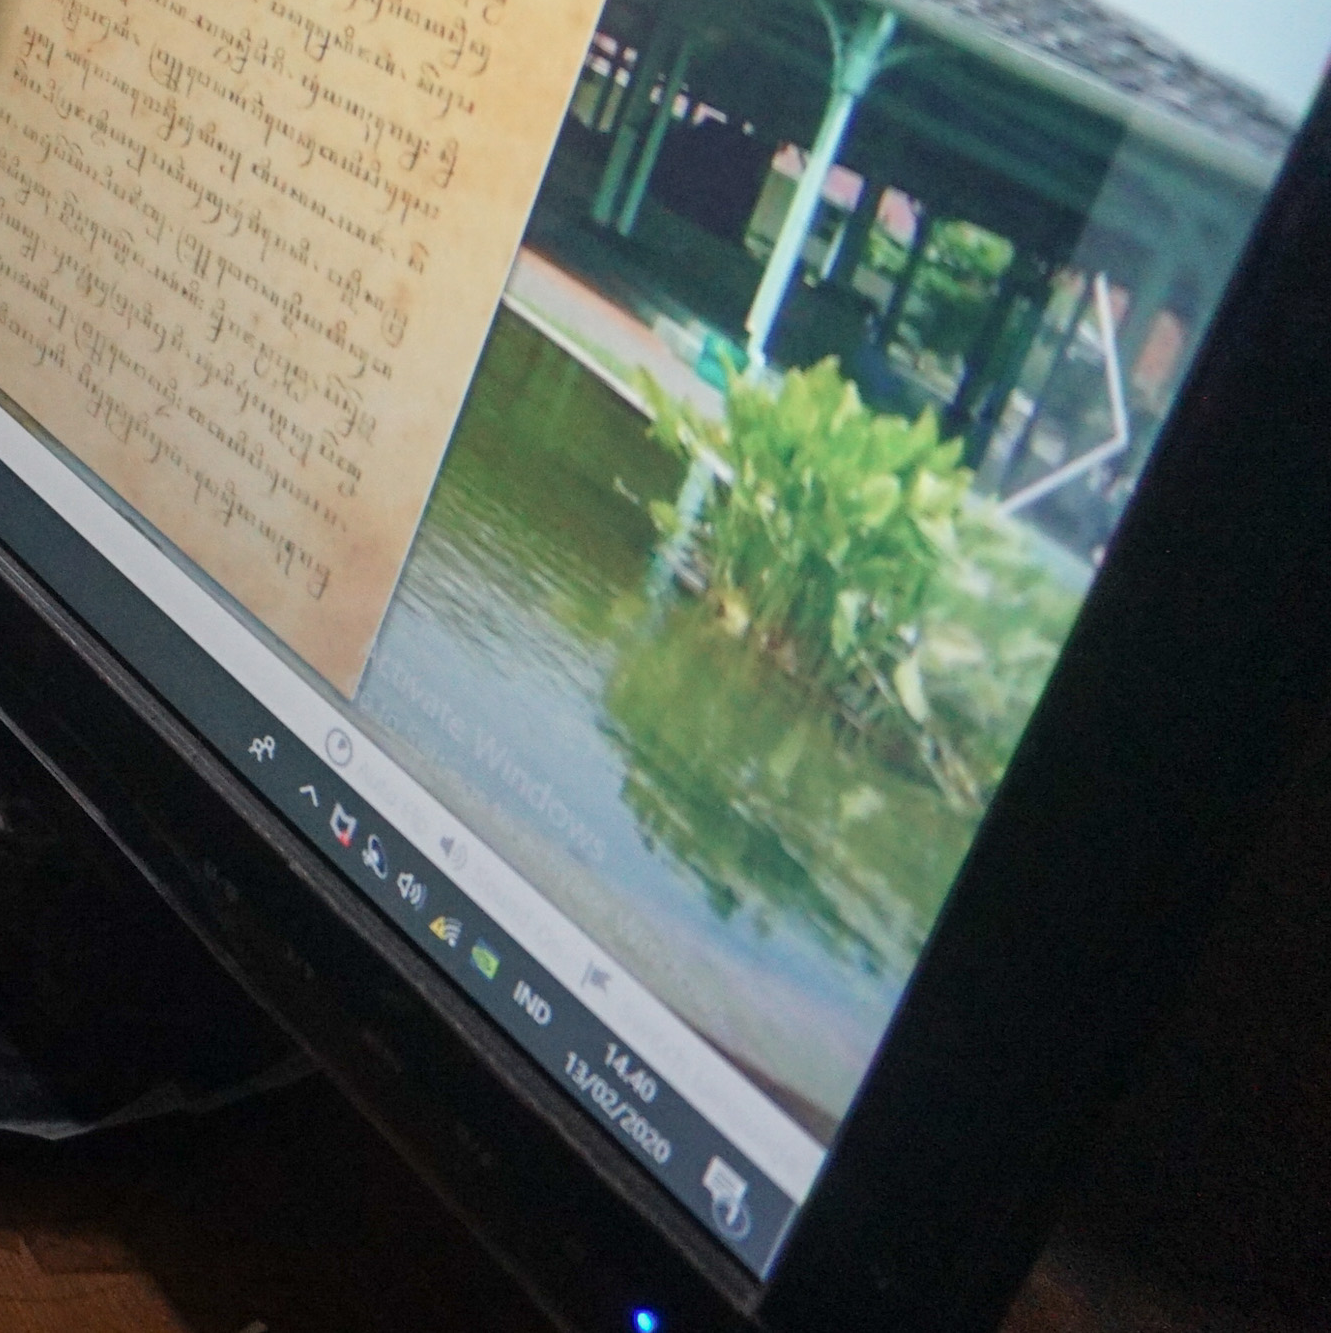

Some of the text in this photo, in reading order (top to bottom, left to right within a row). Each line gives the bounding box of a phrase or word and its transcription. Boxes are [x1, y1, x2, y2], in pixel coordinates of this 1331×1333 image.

[513, 980, 552, 1025] IND
[605, 1042, 658, 1104] 14.40
[565, 1050, 672, 1164] 13/02/2020
